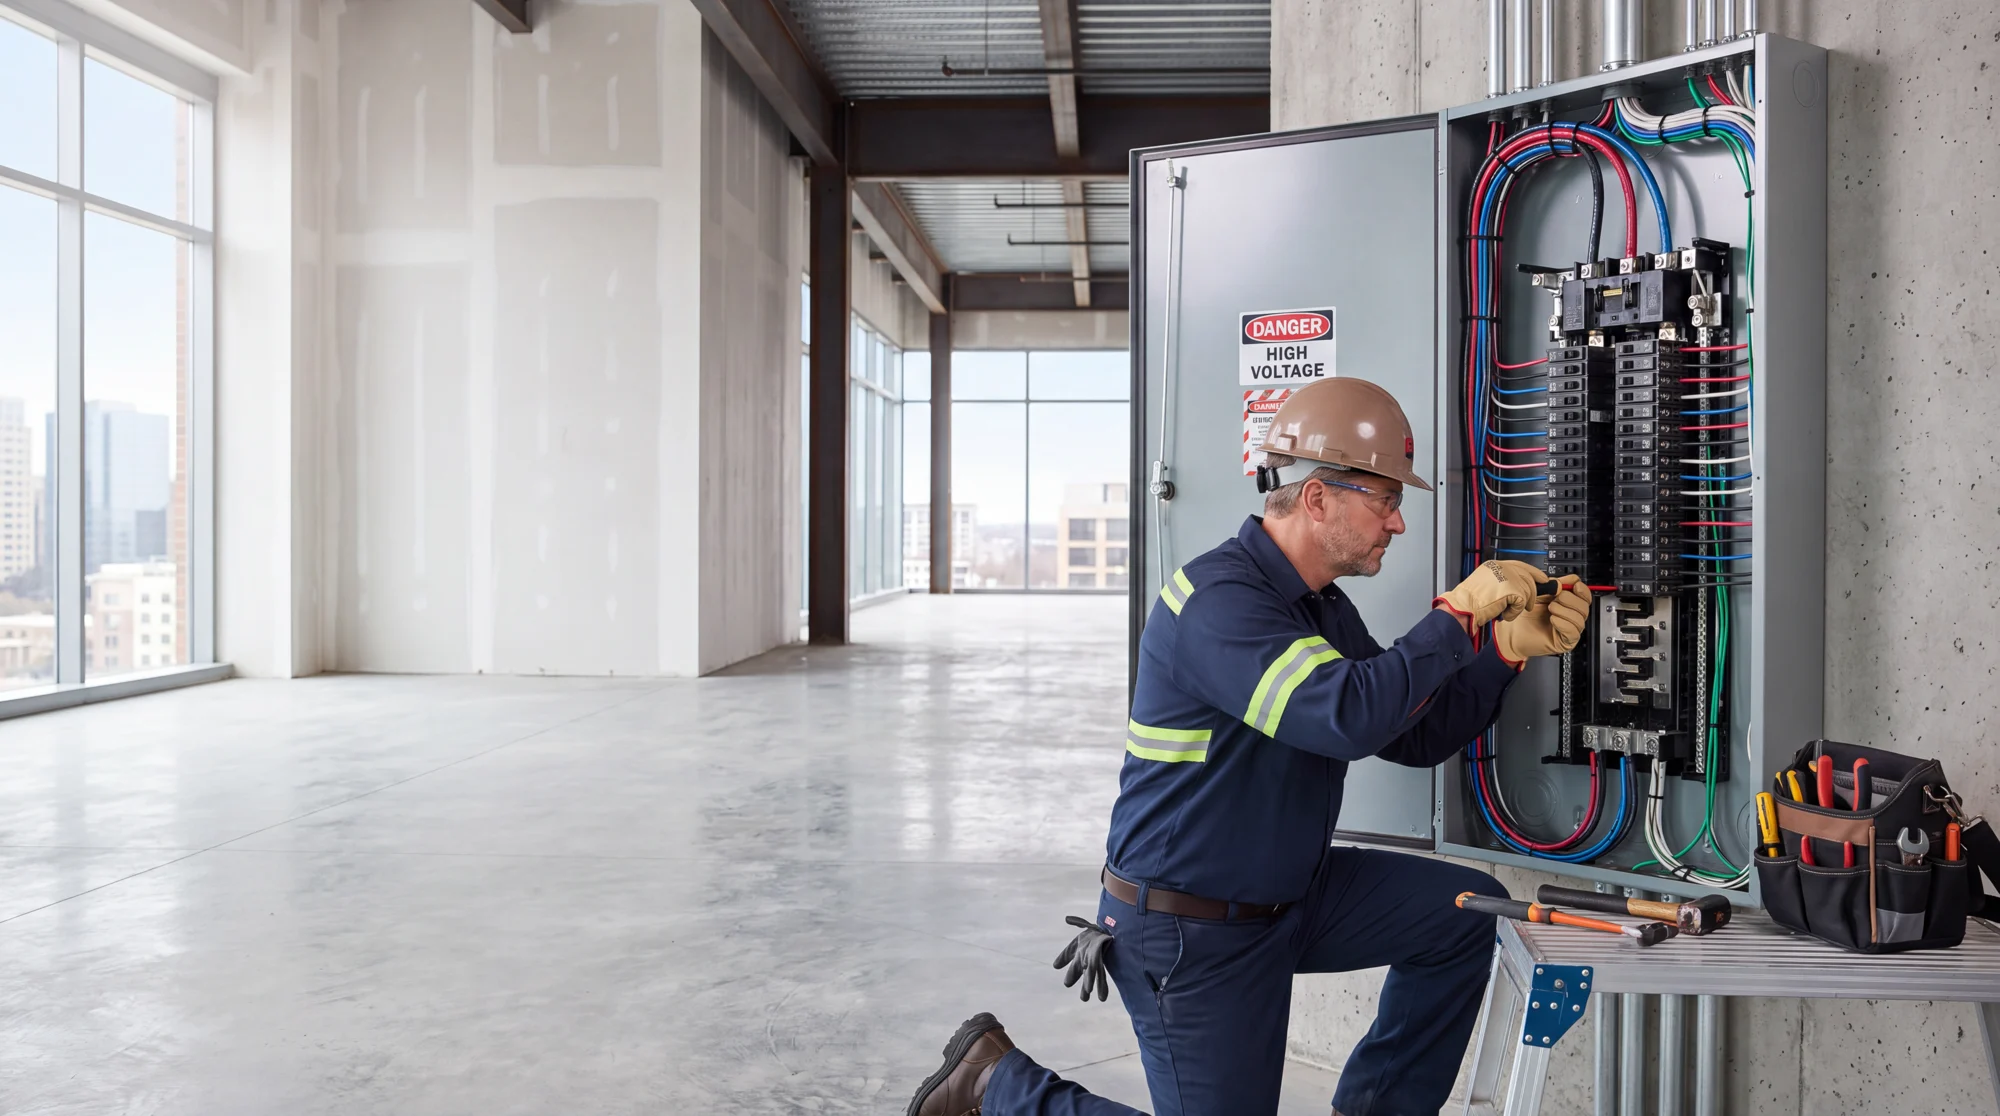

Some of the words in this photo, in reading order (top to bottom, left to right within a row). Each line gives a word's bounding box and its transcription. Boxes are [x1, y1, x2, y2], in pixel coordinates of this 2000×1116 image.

[1253, 317, 1322, 337] DANGER
[1266, 345, 1307, 361] HIGH
[1251, 362, 1324, 379] VOLTAGE
